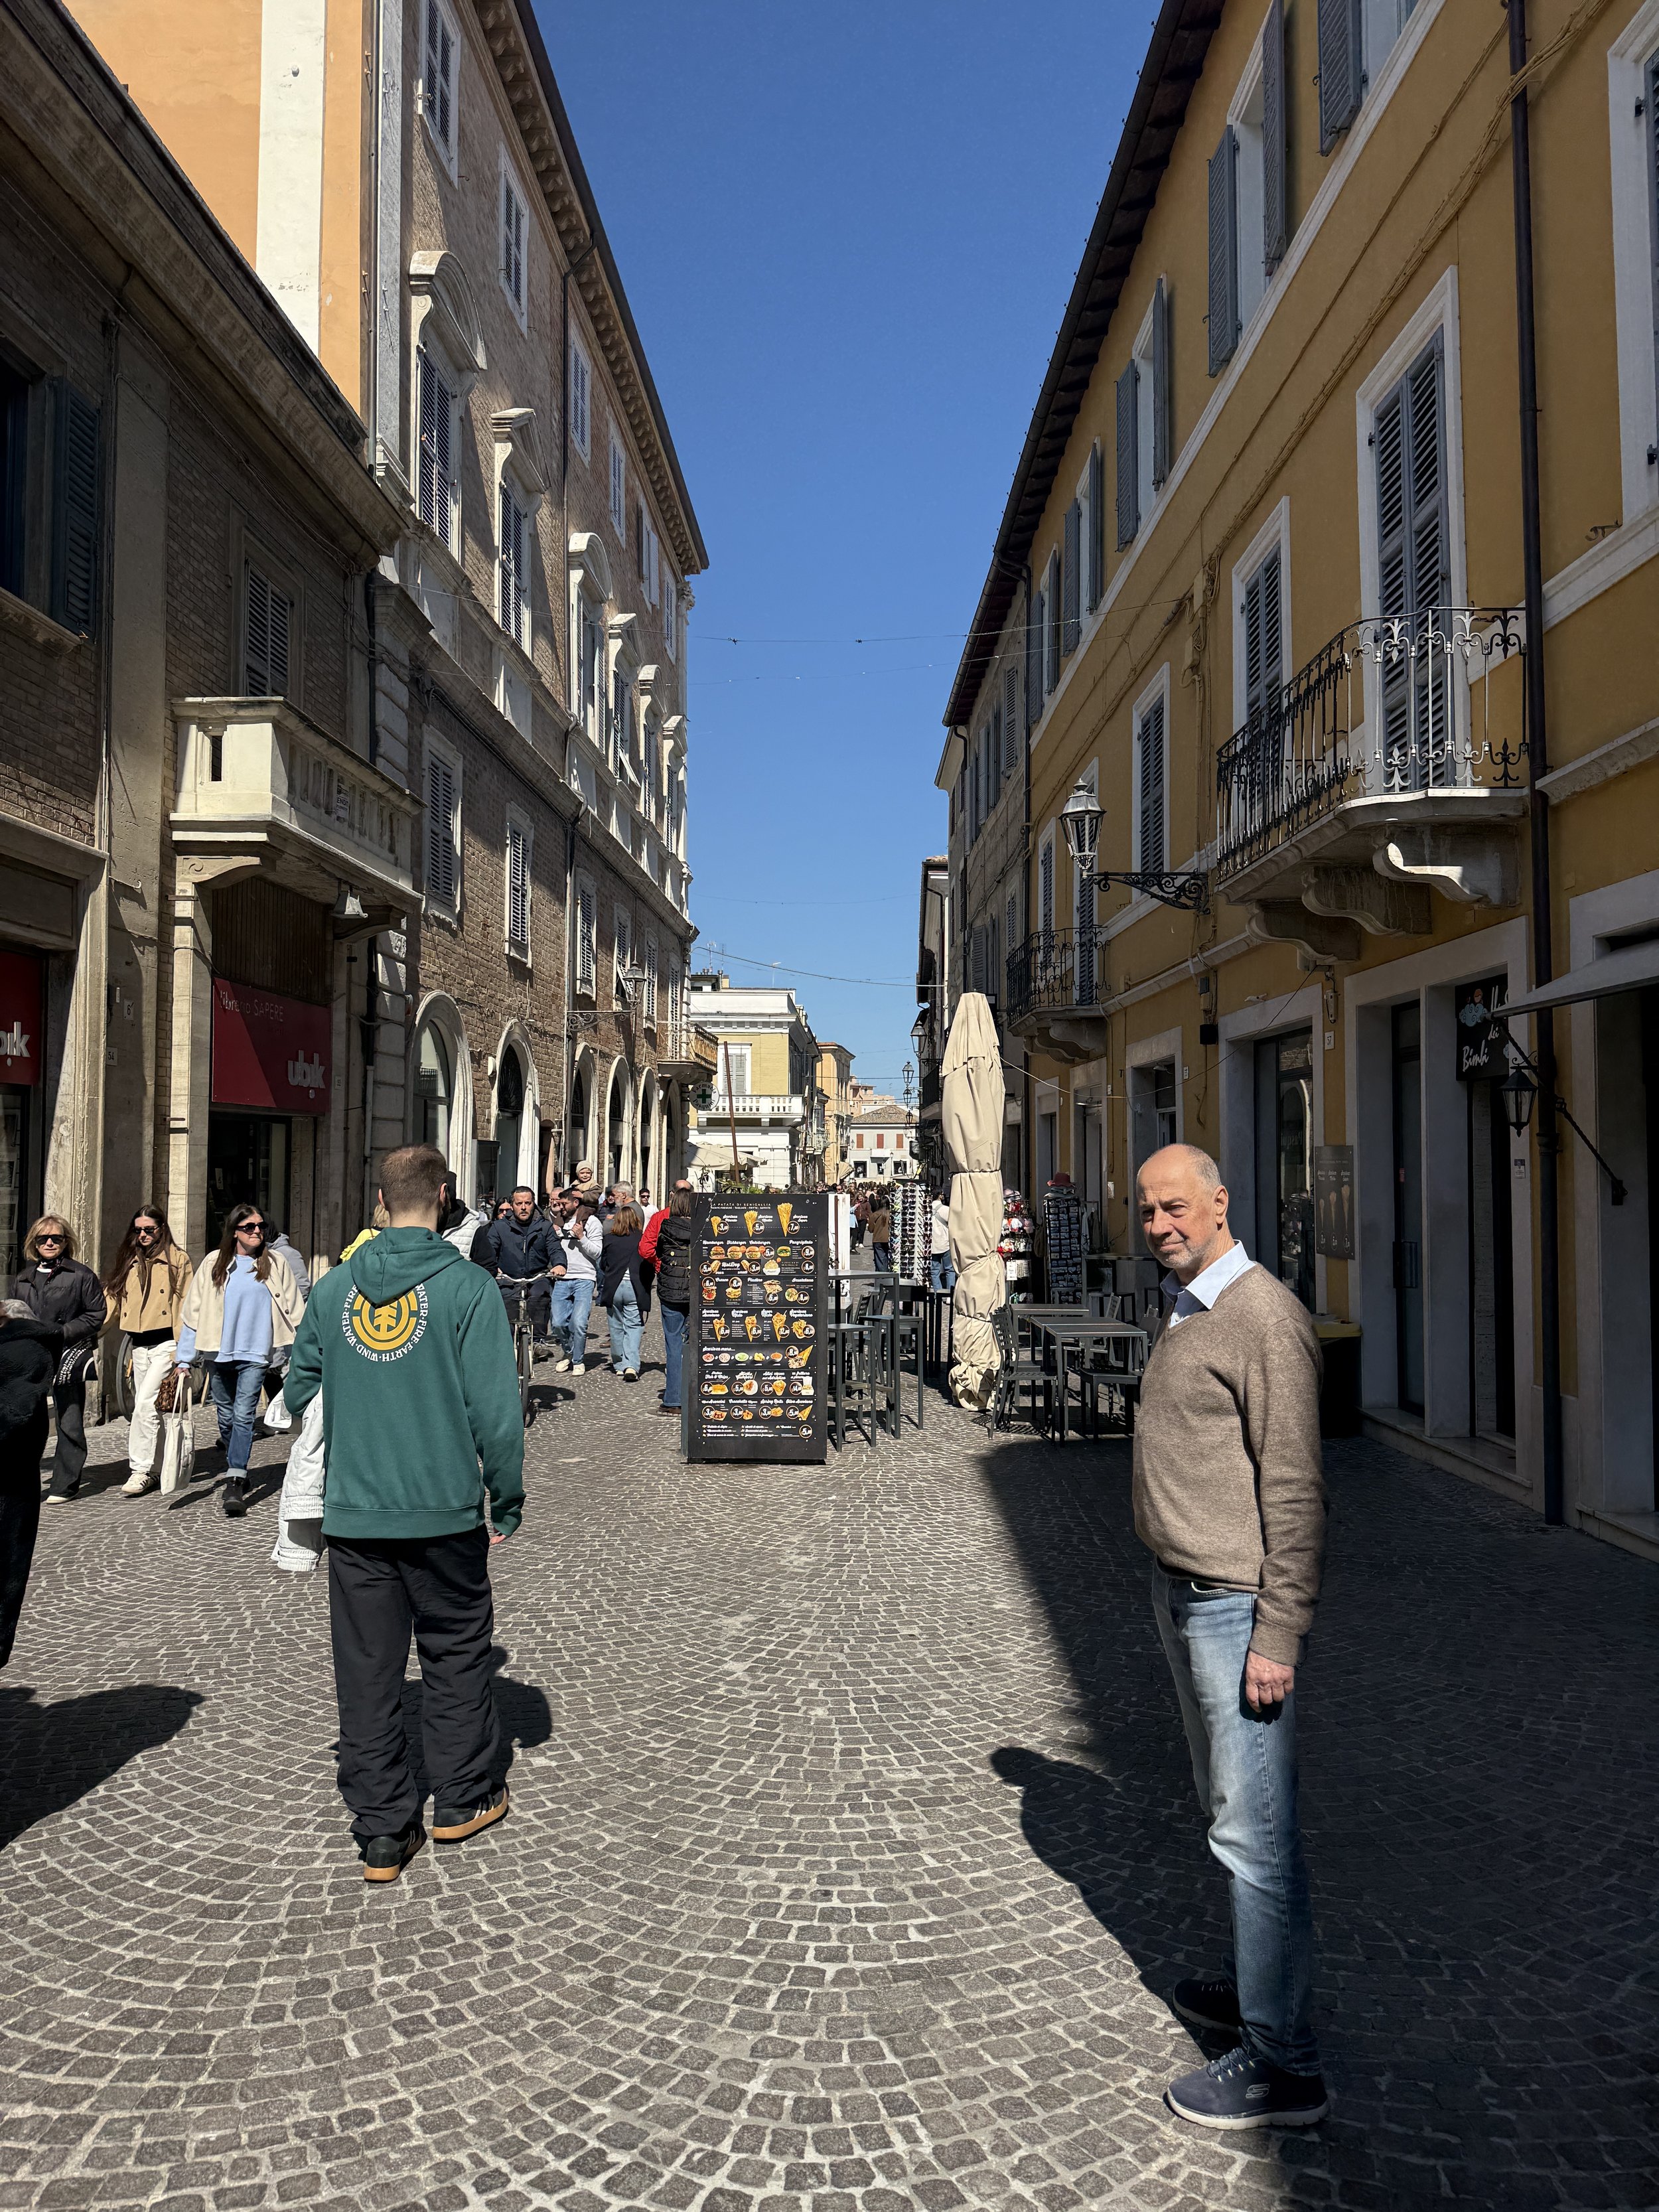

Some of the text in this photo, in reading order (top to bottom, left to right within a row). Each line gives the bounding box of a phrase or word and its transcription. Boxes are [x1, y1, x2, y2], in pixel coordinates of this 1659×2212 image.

[254, 999, 284, 1022] SAPERE
[1327, 1036, 1332, 1046] 57
[1488, 1024, 1499, 1040] dei
[108, 1051, 114, 1060] 54
[1463, 1039, 1489, 1072] Bimbi
[288, 1050, 326, 1098] ubik
[692, 1084, 717, 1094] Farmacia
[693, 1099, 715, 1110] Pasquini
[342, 1311, 357, 1347] WATER
[411, 1319, 427, 1344] FIRE
[356, 1344, 378, 1362] WIND
[382, 1344, 413, 1362] EARTH
